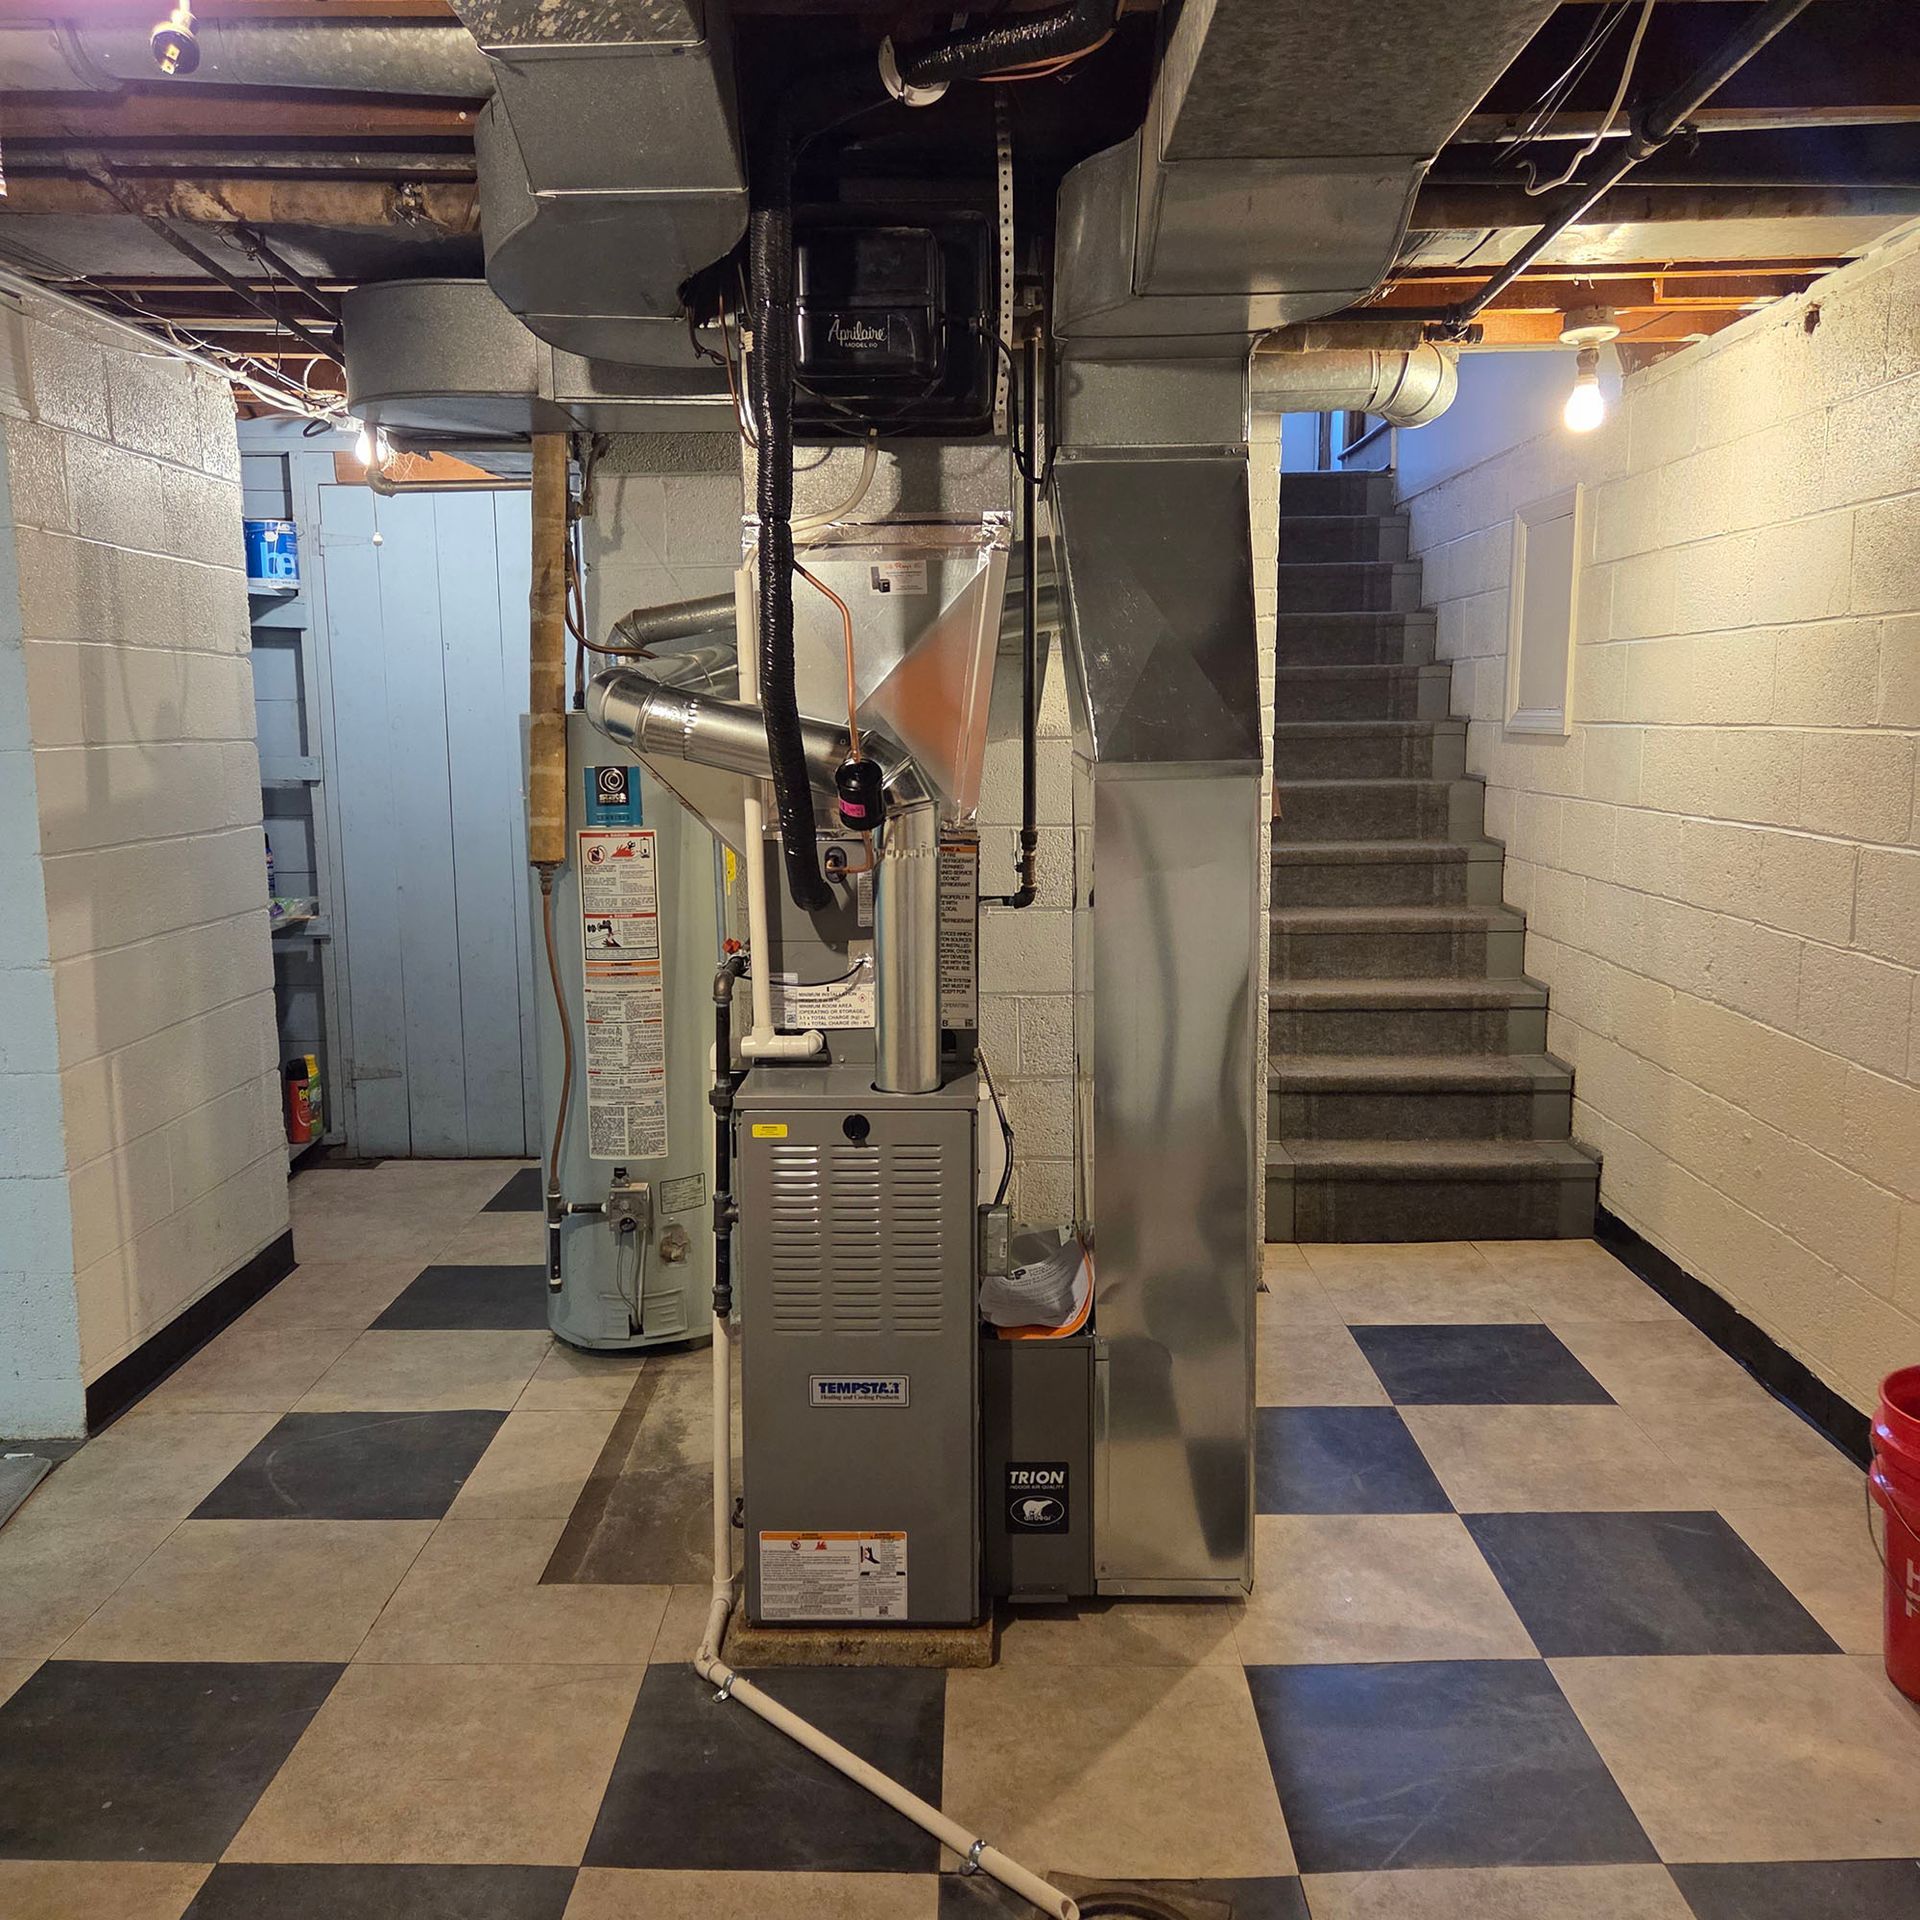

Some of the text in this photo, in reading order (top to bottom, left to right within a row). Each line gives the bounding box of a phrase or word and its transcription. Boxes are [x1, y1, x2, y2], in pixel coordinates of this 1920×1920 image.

[828, 318, 887, 346] Aprilaire
[818, 1382, 900, 1394] TEMPSTAR
[1010, 1471, 1065, 1484] TRION
